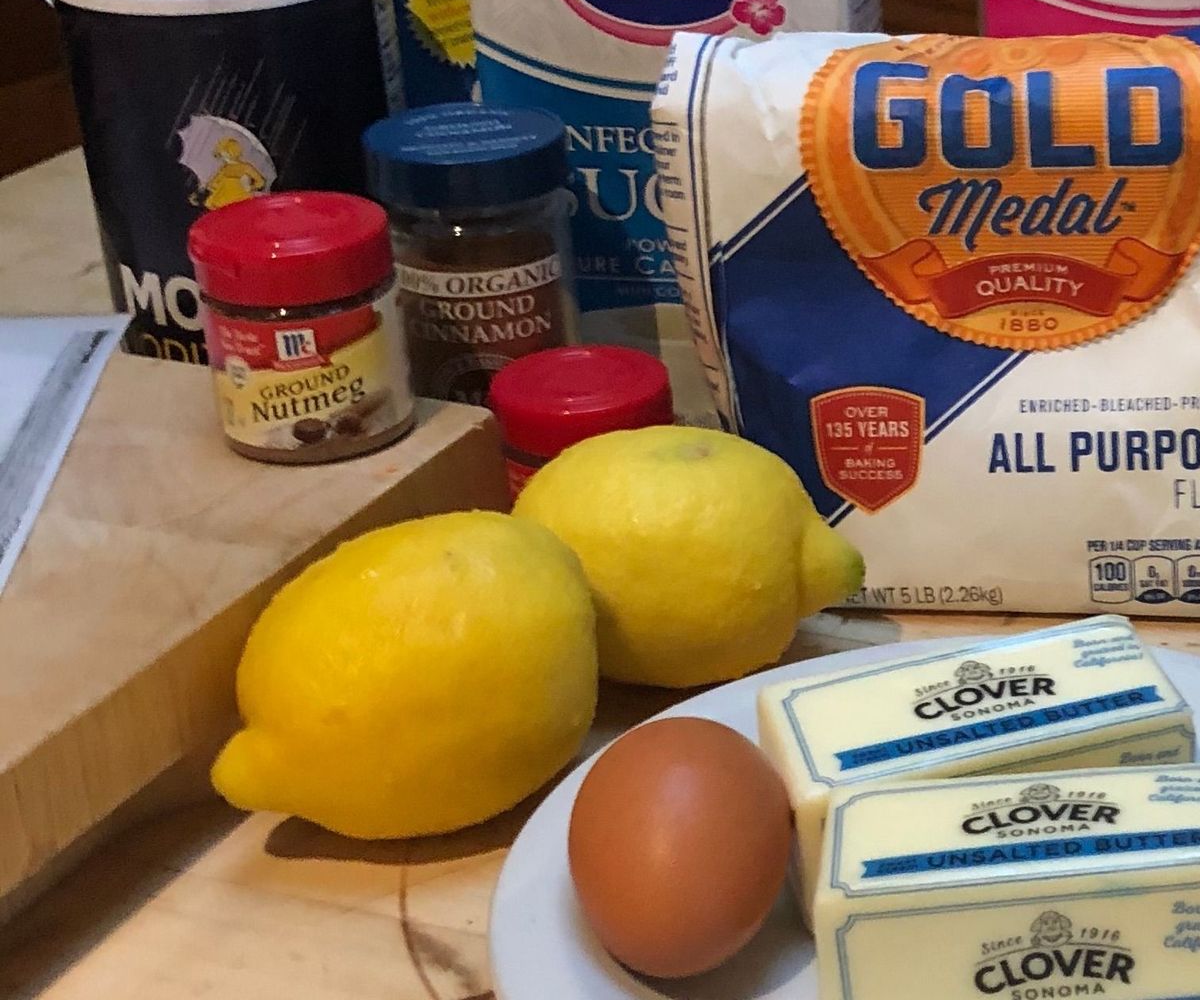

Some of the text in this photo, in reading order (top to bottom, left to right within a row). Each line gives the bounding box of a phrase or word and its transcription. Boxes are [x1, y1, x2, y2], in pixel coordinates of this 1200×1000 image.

[852, 61, 1186, 171] GOLD
[918, 177, 1129, 251] Medal
[987, 263, 1069, 276] PREMIUM
[975, 275, 1086, 297] QUALITY
[999, 317, 1059, 332] 1880
[259, 364, 350, 401] GROUND
[251, 376, 366, 423] Nutmeg
[844, 406, 889, 418] OVER
[826, 421, 910, 438] 135 YEARS
[844, 458, 897, 469] BAKING
[988, 432, 1056, 474] ALL
[839, 470, 904, 480] SUCCESS
[1094, 561, 1127, 581] 100
[870, 586, 896, 605] WT
[900, 586, 913, 605] 5
[915, 586, 936, 604] LB
[939, 585, 1004, 606] (2.26kg)
[913, 677, 1058, 721] CLOVER
[914, 679, 951, 697] Since
[950, 698, 1037, 722] SONOMA
[899, 716, 1035, 755] UNSALTED
[1042, 691, 1146, 722] BUTTER
[971, 796, 1013, 811] Since
[961, 802, 1121, 836] CLOVER
[996, 823, 1092, 839] SONOMA
[926, 841, 1083, 869] UNSALTED
[980, 927, 1121, 956] Since 1916
[973, 949, 1136, 995] CLOVER
[1011, 983, 1106, 1000] SONOMA
